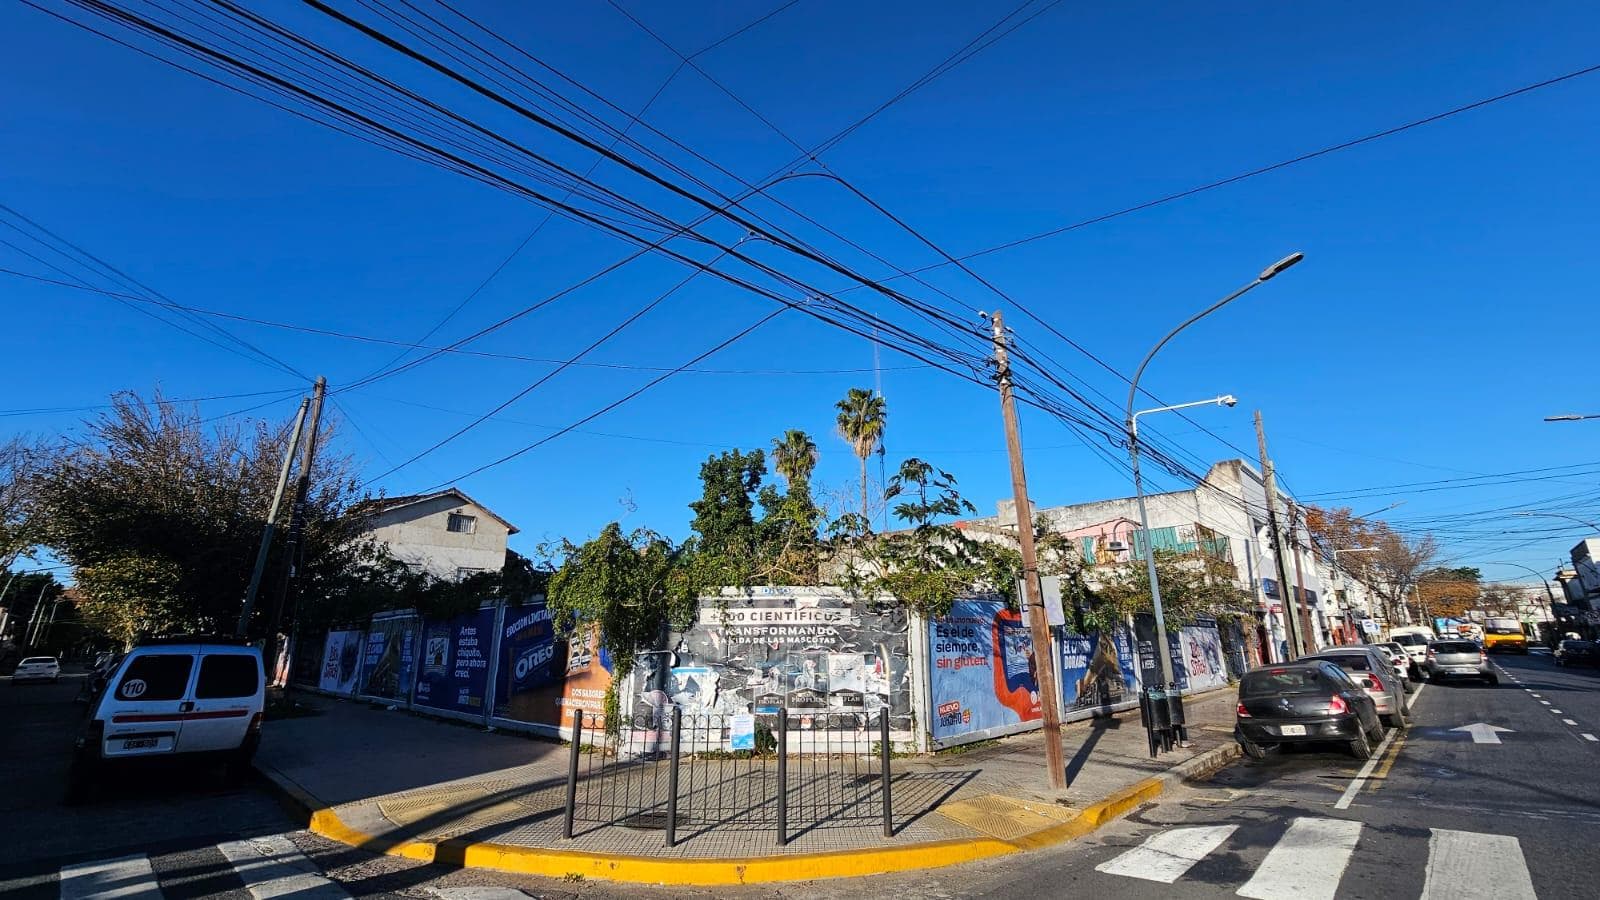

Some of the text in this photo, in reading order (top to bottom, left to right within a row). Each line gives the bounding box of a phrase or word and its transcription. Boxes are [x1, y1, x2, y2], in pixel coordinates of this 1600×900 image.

[710, 609, 744, 621] +00
[459, 626, 477, 636] Antes
[717, 626, 834, 636] TRANSFORMANDO
[936, 625, 974, 637] Es el de
[458, 637, 478, 646] estaba
[787, 636, 836, 645] MASCOTAS
[936, 640, 980, 655] siempre,
[455, 659, 487, 669] pero ahora
[515, 645, 554, 679] OREO
[936, 655, 952, 668] sin
[124, 682, 145, 694] 110
[939, 702, 959, 715] NUEVO
